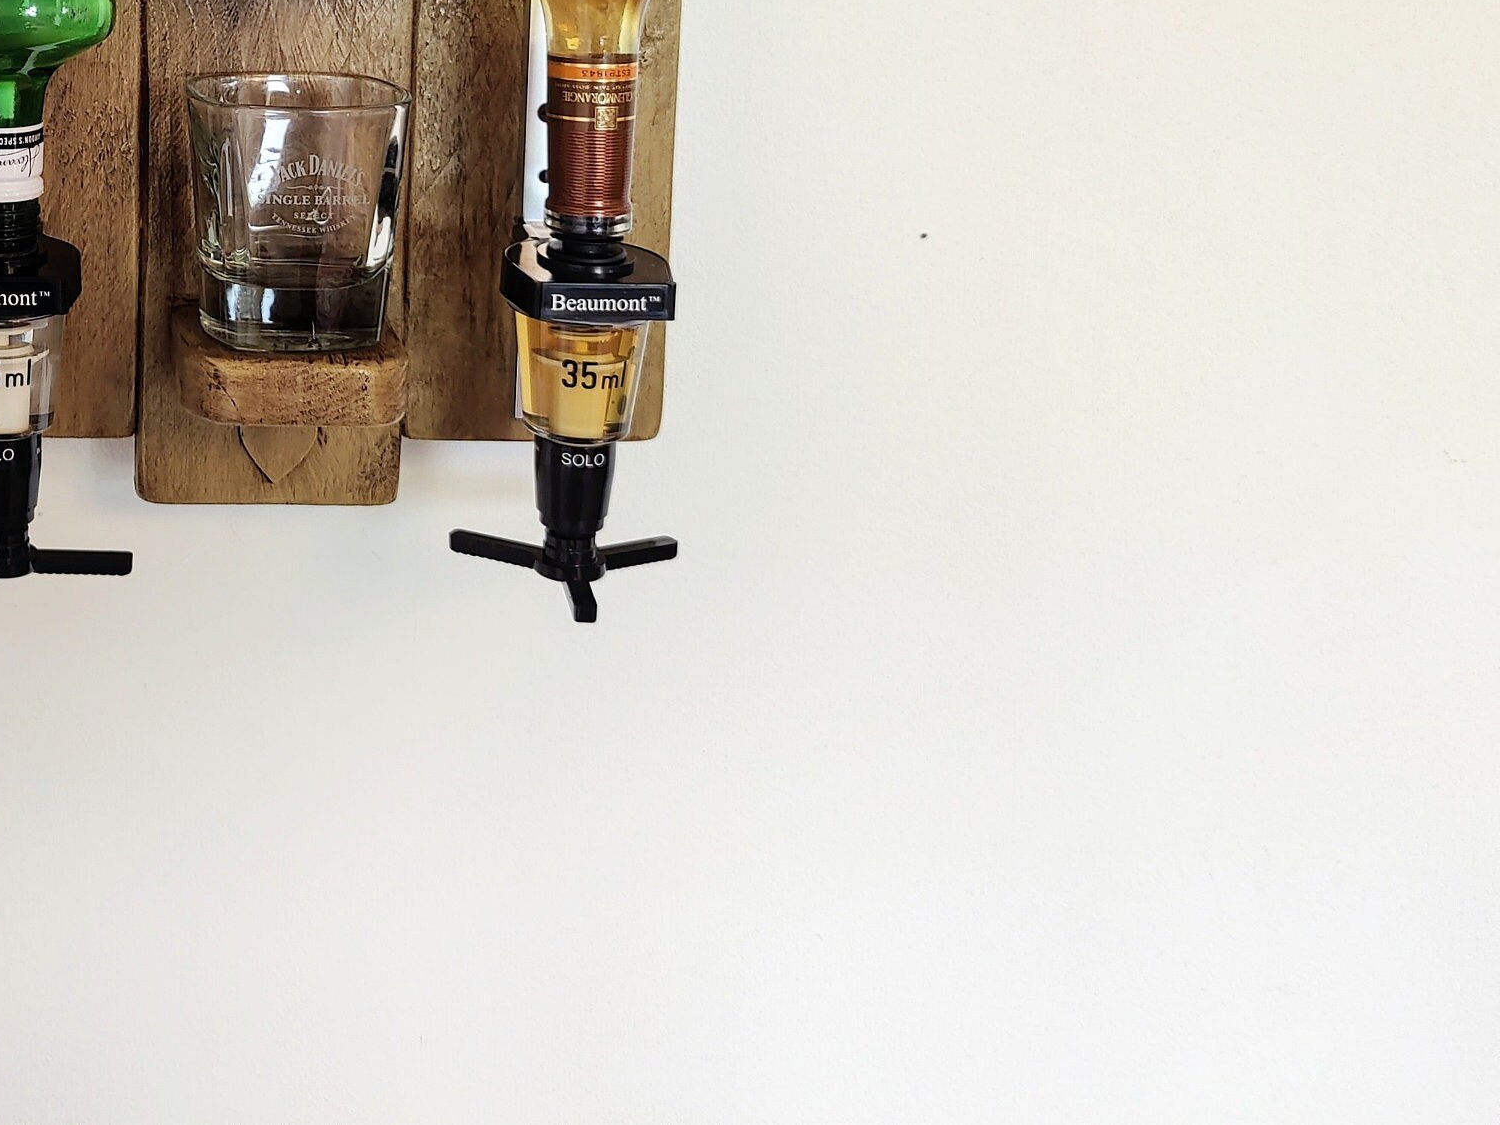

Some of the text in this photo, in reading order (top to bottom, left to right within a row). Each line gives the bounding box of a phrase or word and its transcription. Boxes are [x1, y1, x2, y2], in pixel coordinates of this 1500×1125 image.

[257, 194, 371, 206] SINGLE BARREL
[561, 452, 605, 467] SOLO
